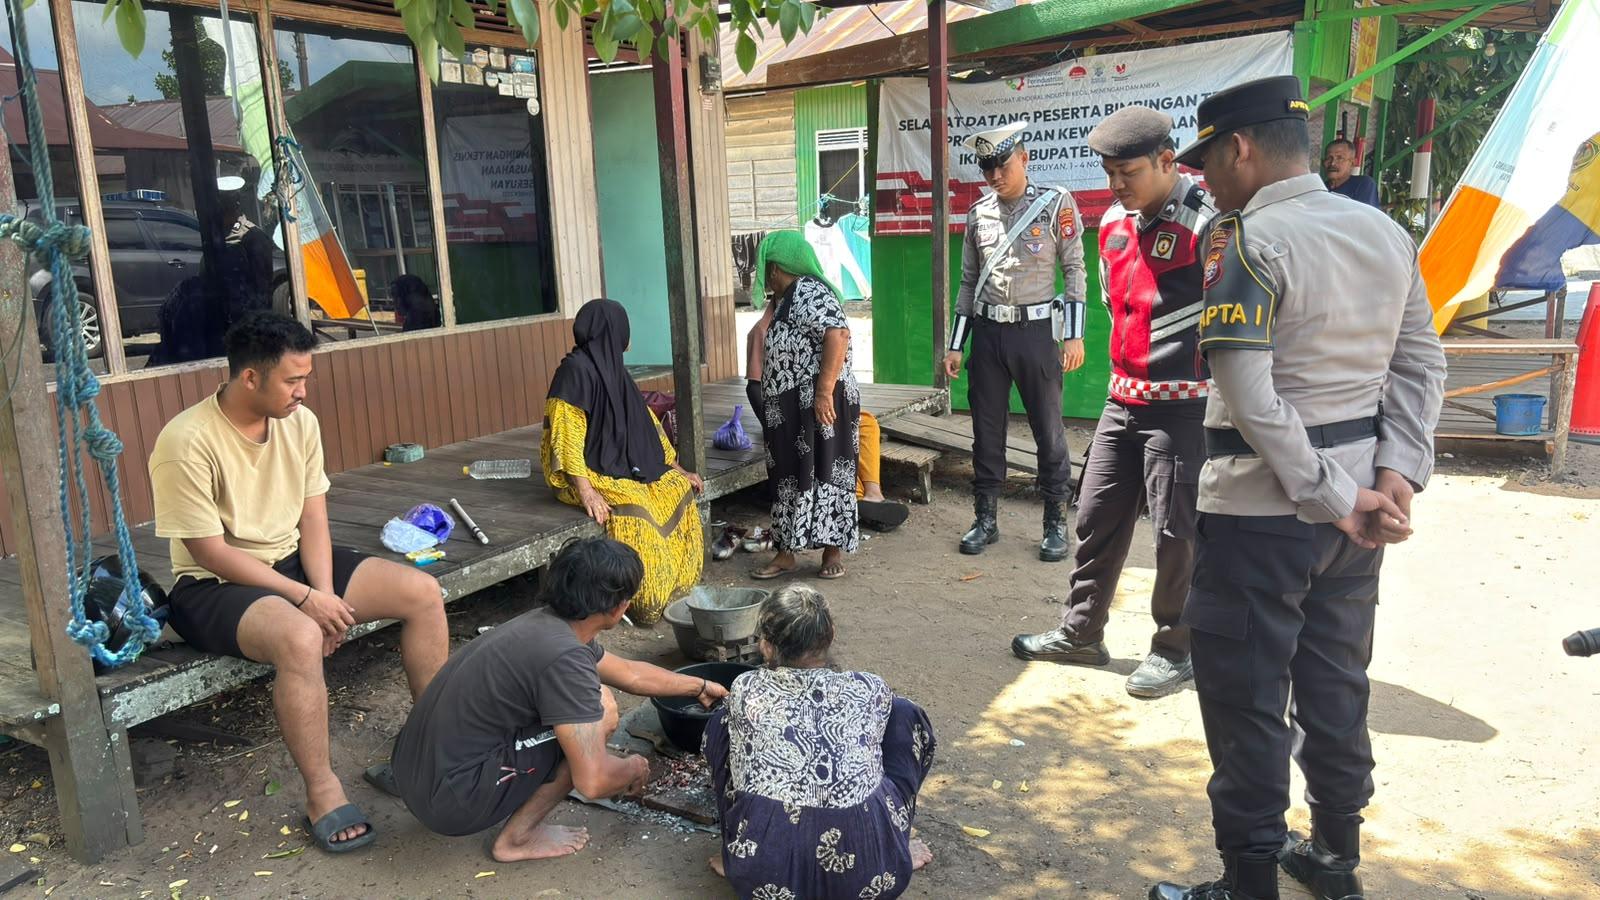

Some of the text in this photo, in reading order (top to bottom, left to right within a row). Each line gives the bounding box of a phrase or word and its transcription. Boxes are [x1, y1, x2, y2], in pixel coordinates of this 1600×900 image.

[965, 112, 1030, 127] DATANG
[1033, 103, 1101, 123] PESERTA
[1021, 129, 1055, 142] DAN
